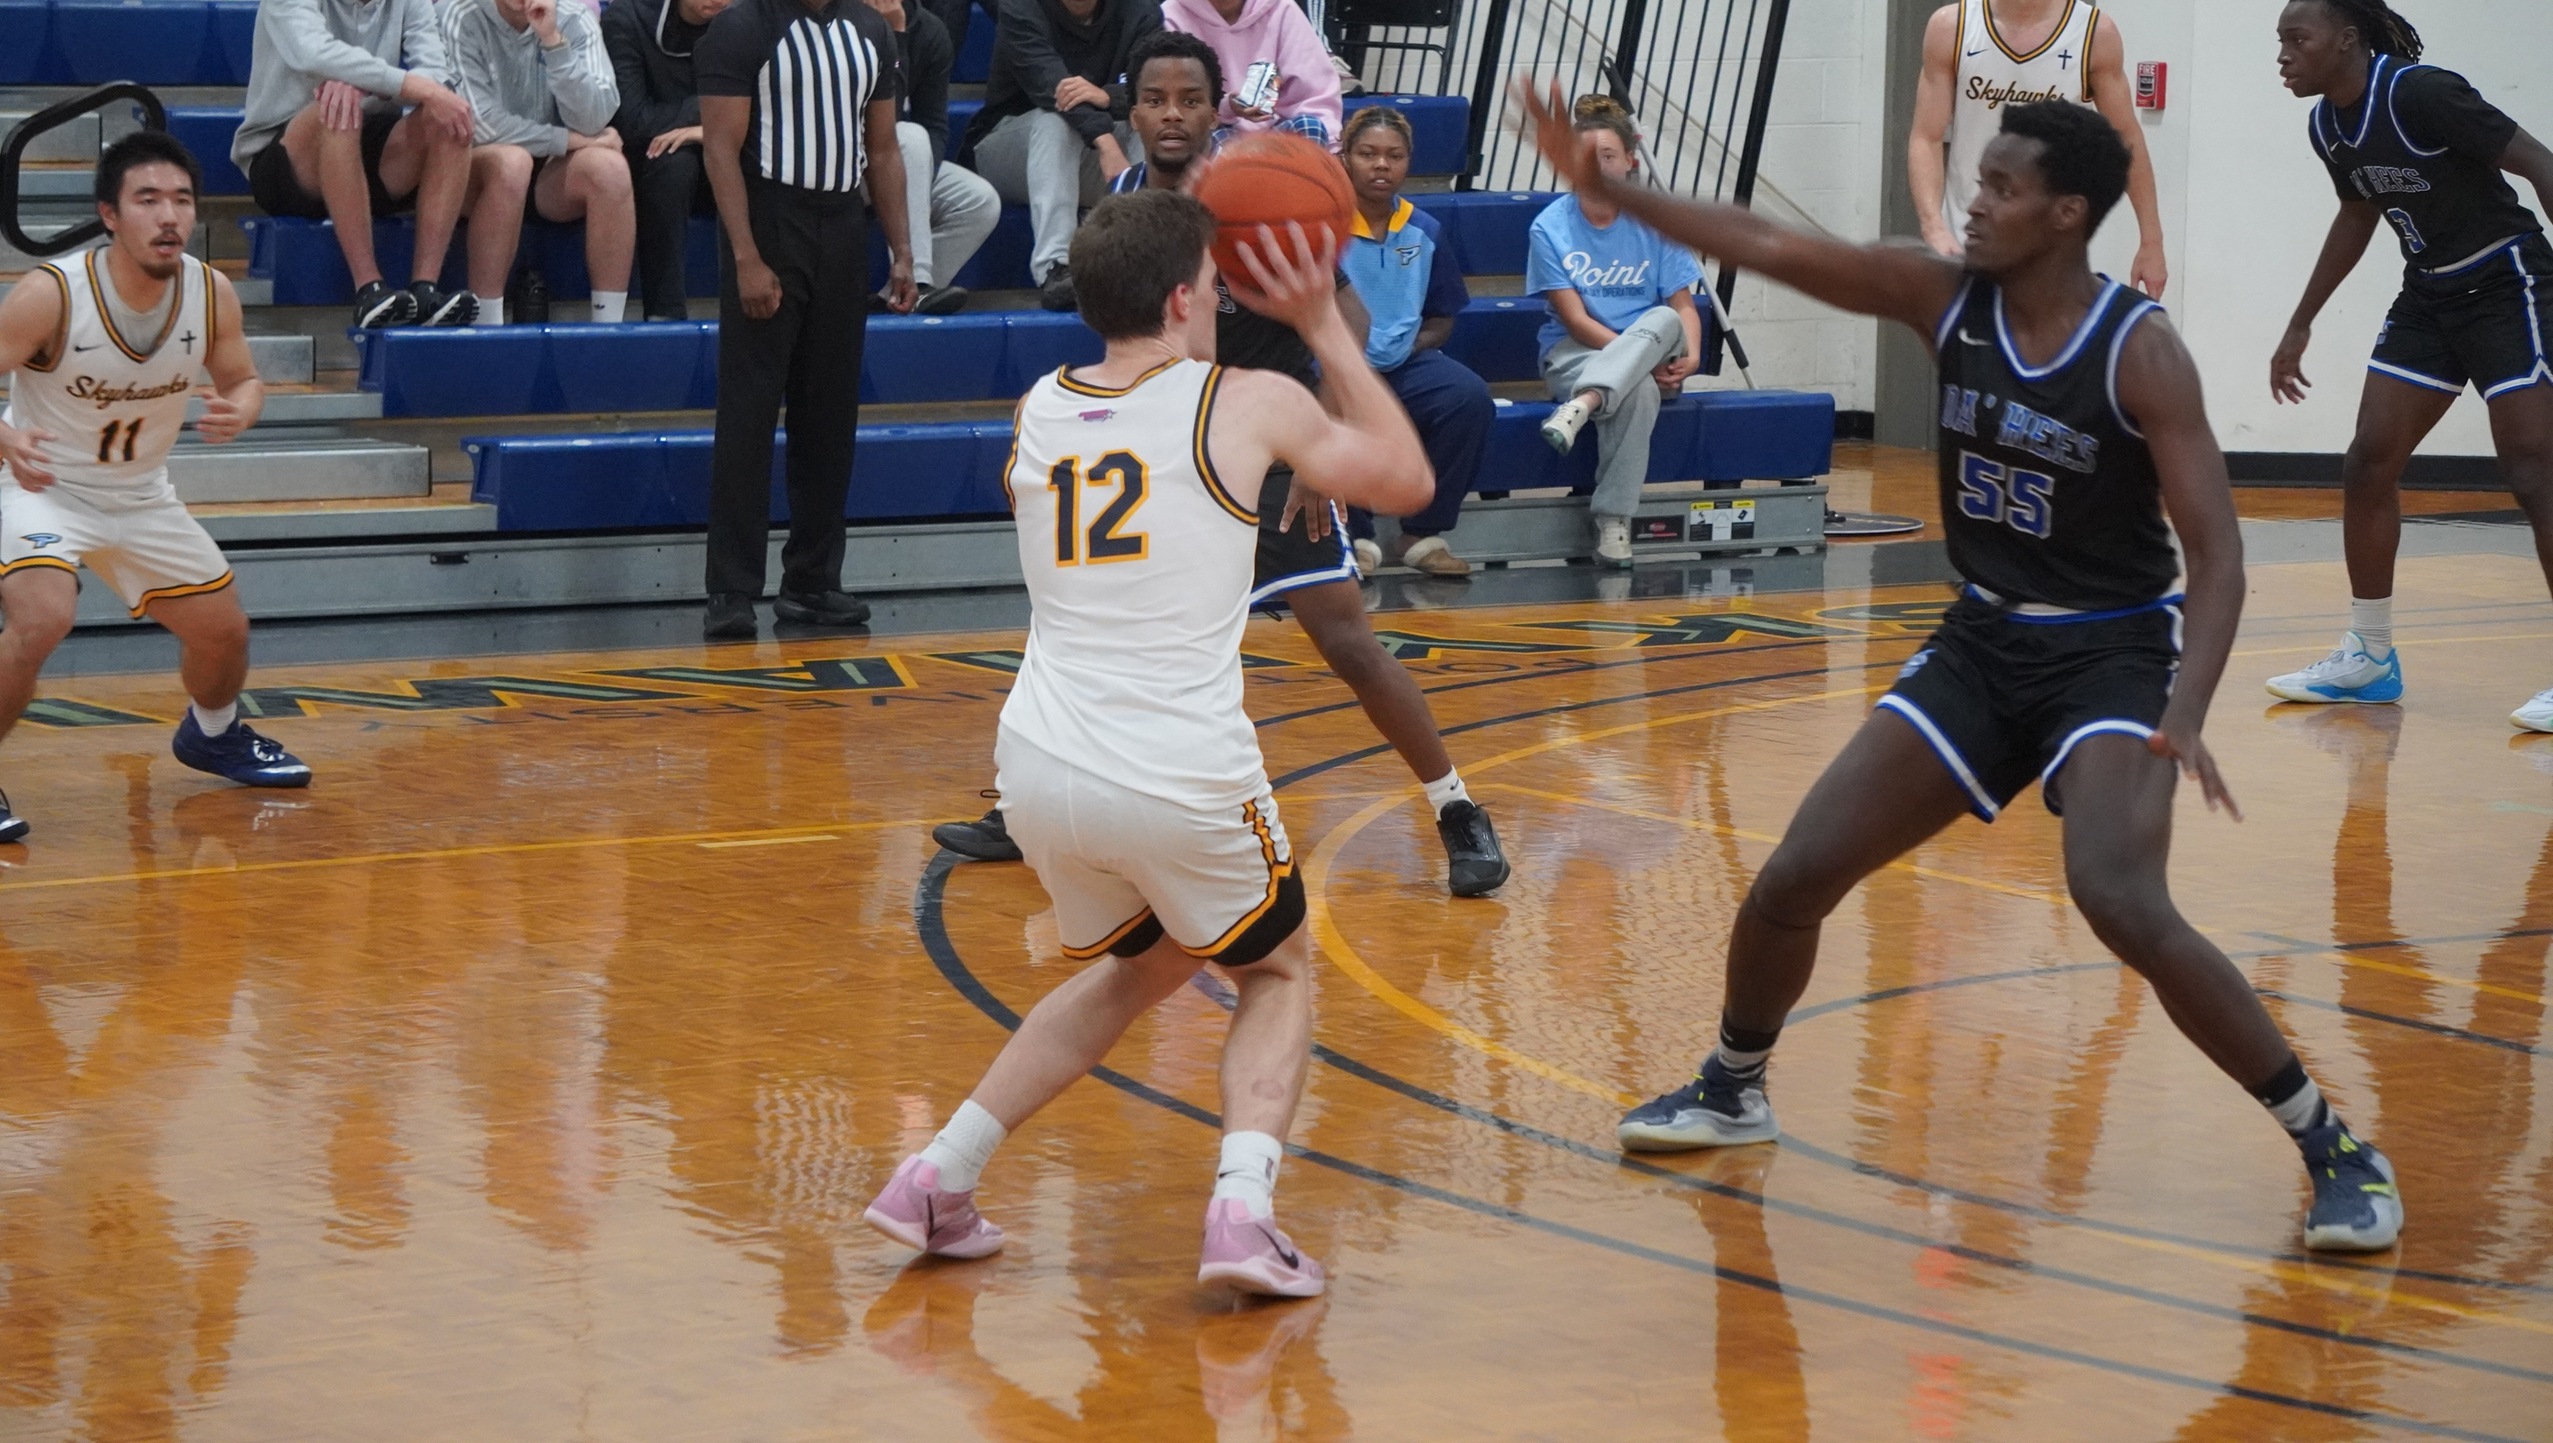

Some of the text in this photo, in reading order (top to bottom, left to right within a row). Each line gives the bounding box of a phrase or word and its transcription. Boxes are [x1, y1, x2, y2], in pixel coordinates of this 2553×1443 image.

[2139, 63, 2156, 76] FIRE
[2386, 207, 2427, 253] 3
[1562, 250, 1651, 287] Point
[65, 373, 190, 410] Skyhawks
[97, 416, 146, 465] 11
[1047, 447, 1150, 568] 12
[1957, 449, 2056, 540] 55
